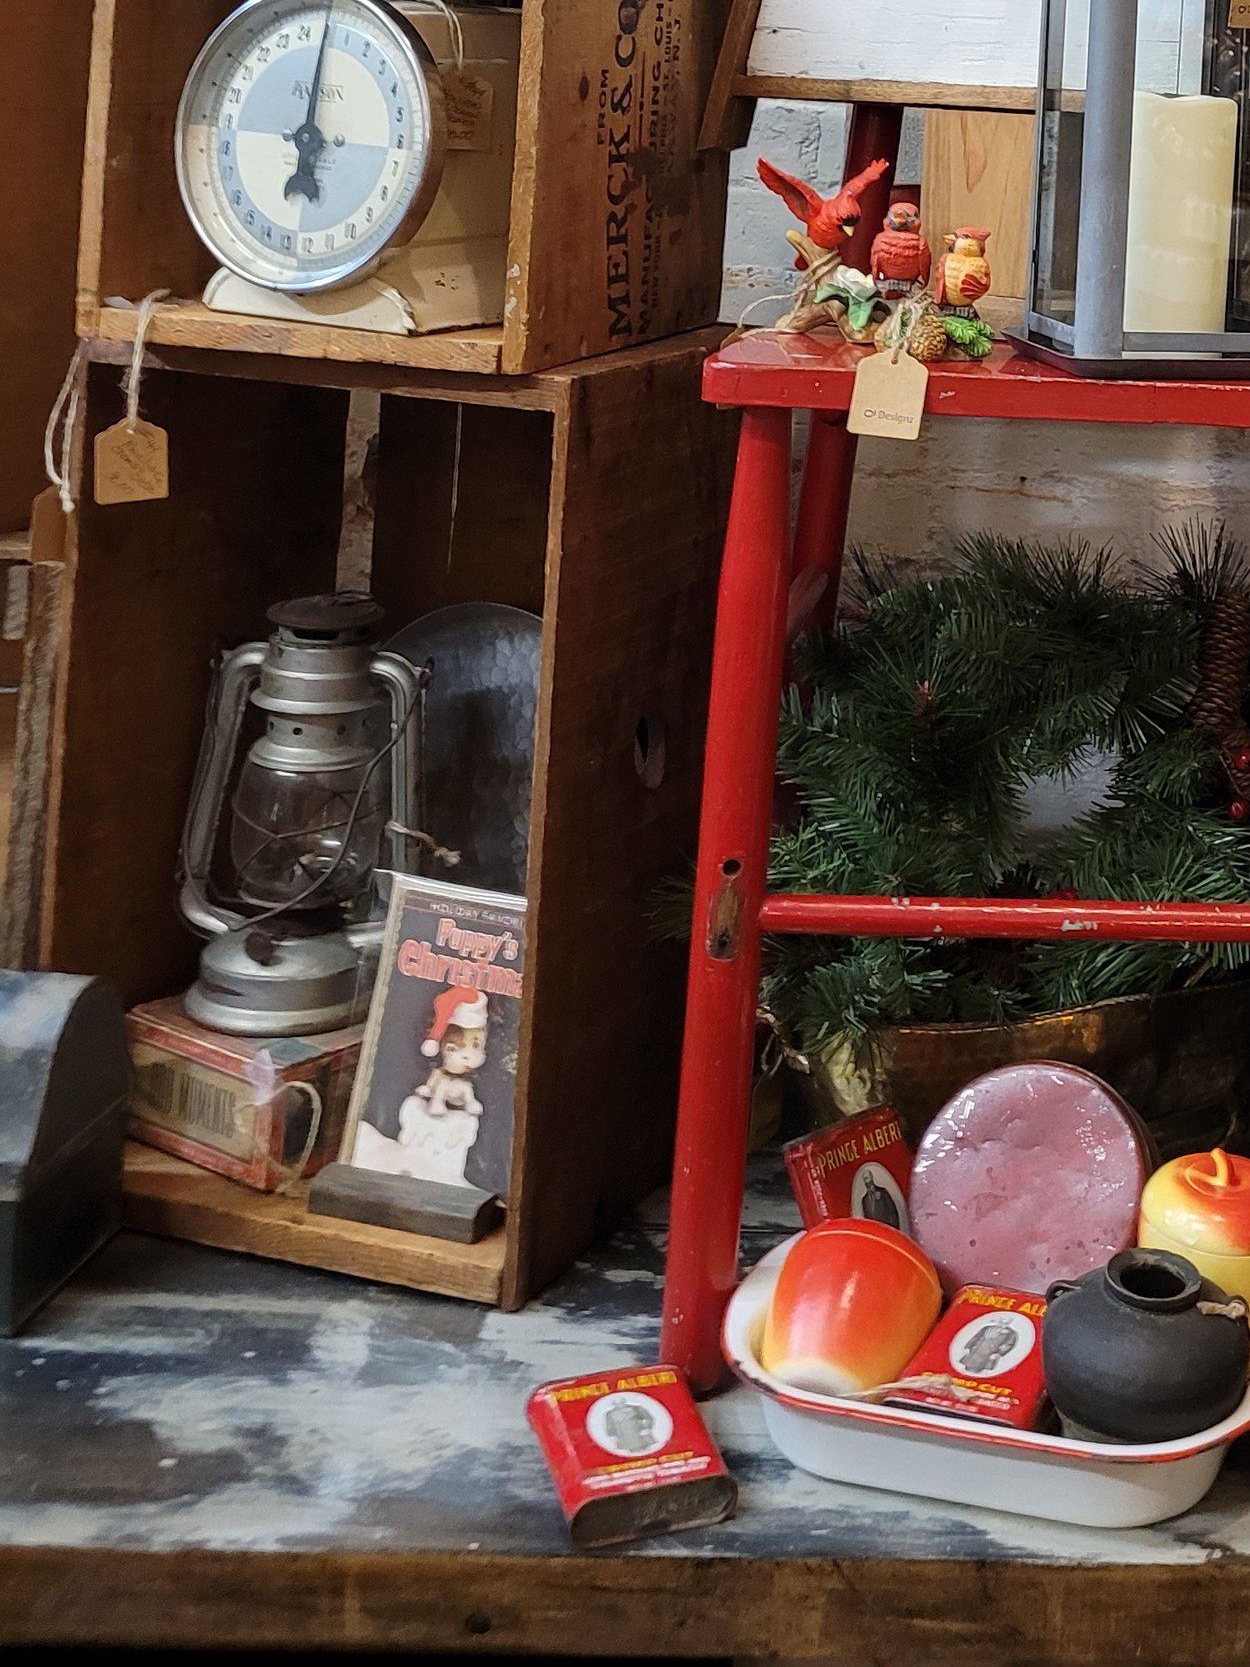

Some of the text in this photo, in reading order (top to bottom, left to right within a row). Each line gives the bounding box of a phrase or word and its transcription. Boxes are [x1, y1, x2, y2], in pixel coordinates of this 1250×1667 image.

[362, 40, 372, 59] 2
[395, 106, 405, 124] 5
[597, 68, 609, 146] FROM
[609, 75, 633, 116] &
[652, 234, 662, 273] YORK
[663, 20, 673, 64] LOUIS
[606, 124, 633, 342] MERCK
[877, 410, 915, 425] Designz
[436, 918, 519, 961] Puppy's
[398, 939, 523, 999] Christma
[817, 1139, 861, 1179] PRINCE
[956, 1288, 1018, 1311] PRINCE
